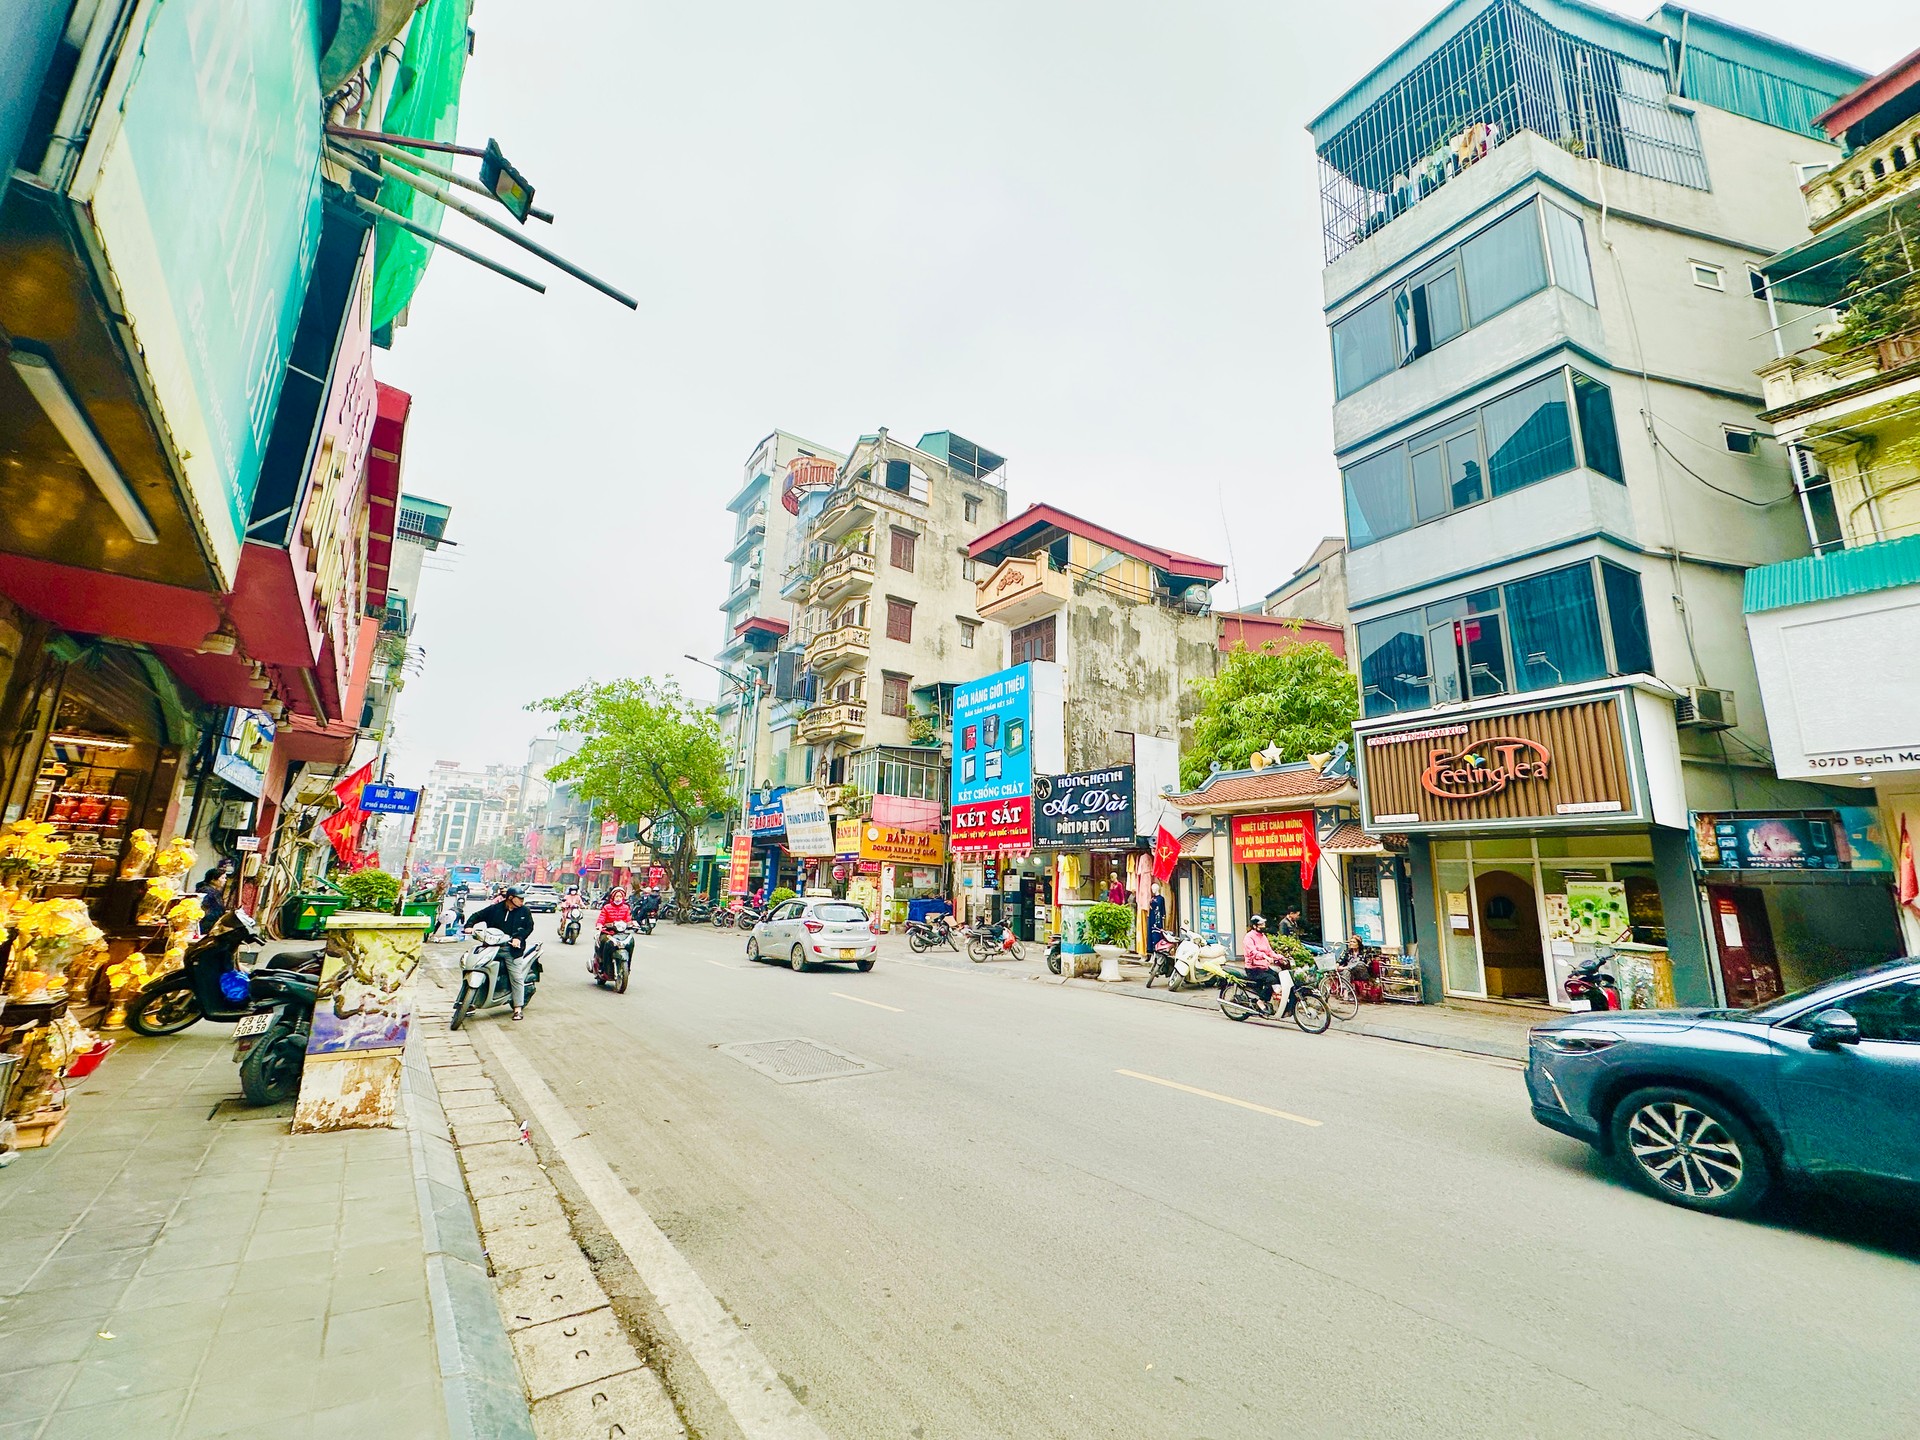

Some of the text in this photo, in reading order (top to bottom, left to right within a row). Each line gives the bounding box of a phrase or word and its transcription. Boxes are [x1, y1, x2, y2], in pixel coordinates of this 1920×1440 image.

[245, 287, 281, 457] CHI
[957, 675, 1025, 709] CỬA HÀNG GIỚI THIỆU
[1394, 735, 1404, 743] TY
[1406, 732, 1427, 742] TNHH
[1427, 743, 1550, 793] Feeling Tea
[1808, 757, 1849, 769] 307D
[1854, 753, 1894, 767] Bạch
[393, 790, 406, 800] 300
[958, 780, 1024, 802] KÉT CHỐNG CHÁY
[1042, 787, 1129, 817] Áo Dài
[956, 800, 1022, 829] KÉT SẮT
[1090, 815, 1110, 837] HỘI
[1257, 820, 1269, 832] LIỆT
[1269, 819, 1284, 830] CHÀO
[1285, 818, 1303, 829] MỪNG
[886, 832, 930, 846] BÁNH MÌ
[1265, 832, 1279, 844] BIỂU
[1279, 832, 1295, 843] TOÀN
[872, 845, 892, 853] DONER
[1242, 847, 1254, 859] LẦN
[1254, 847, 1265, 858] THỨ
[1275, 846, 1288, 857] CỦA
[1288, 844, 1303, 857] ĐẢN
